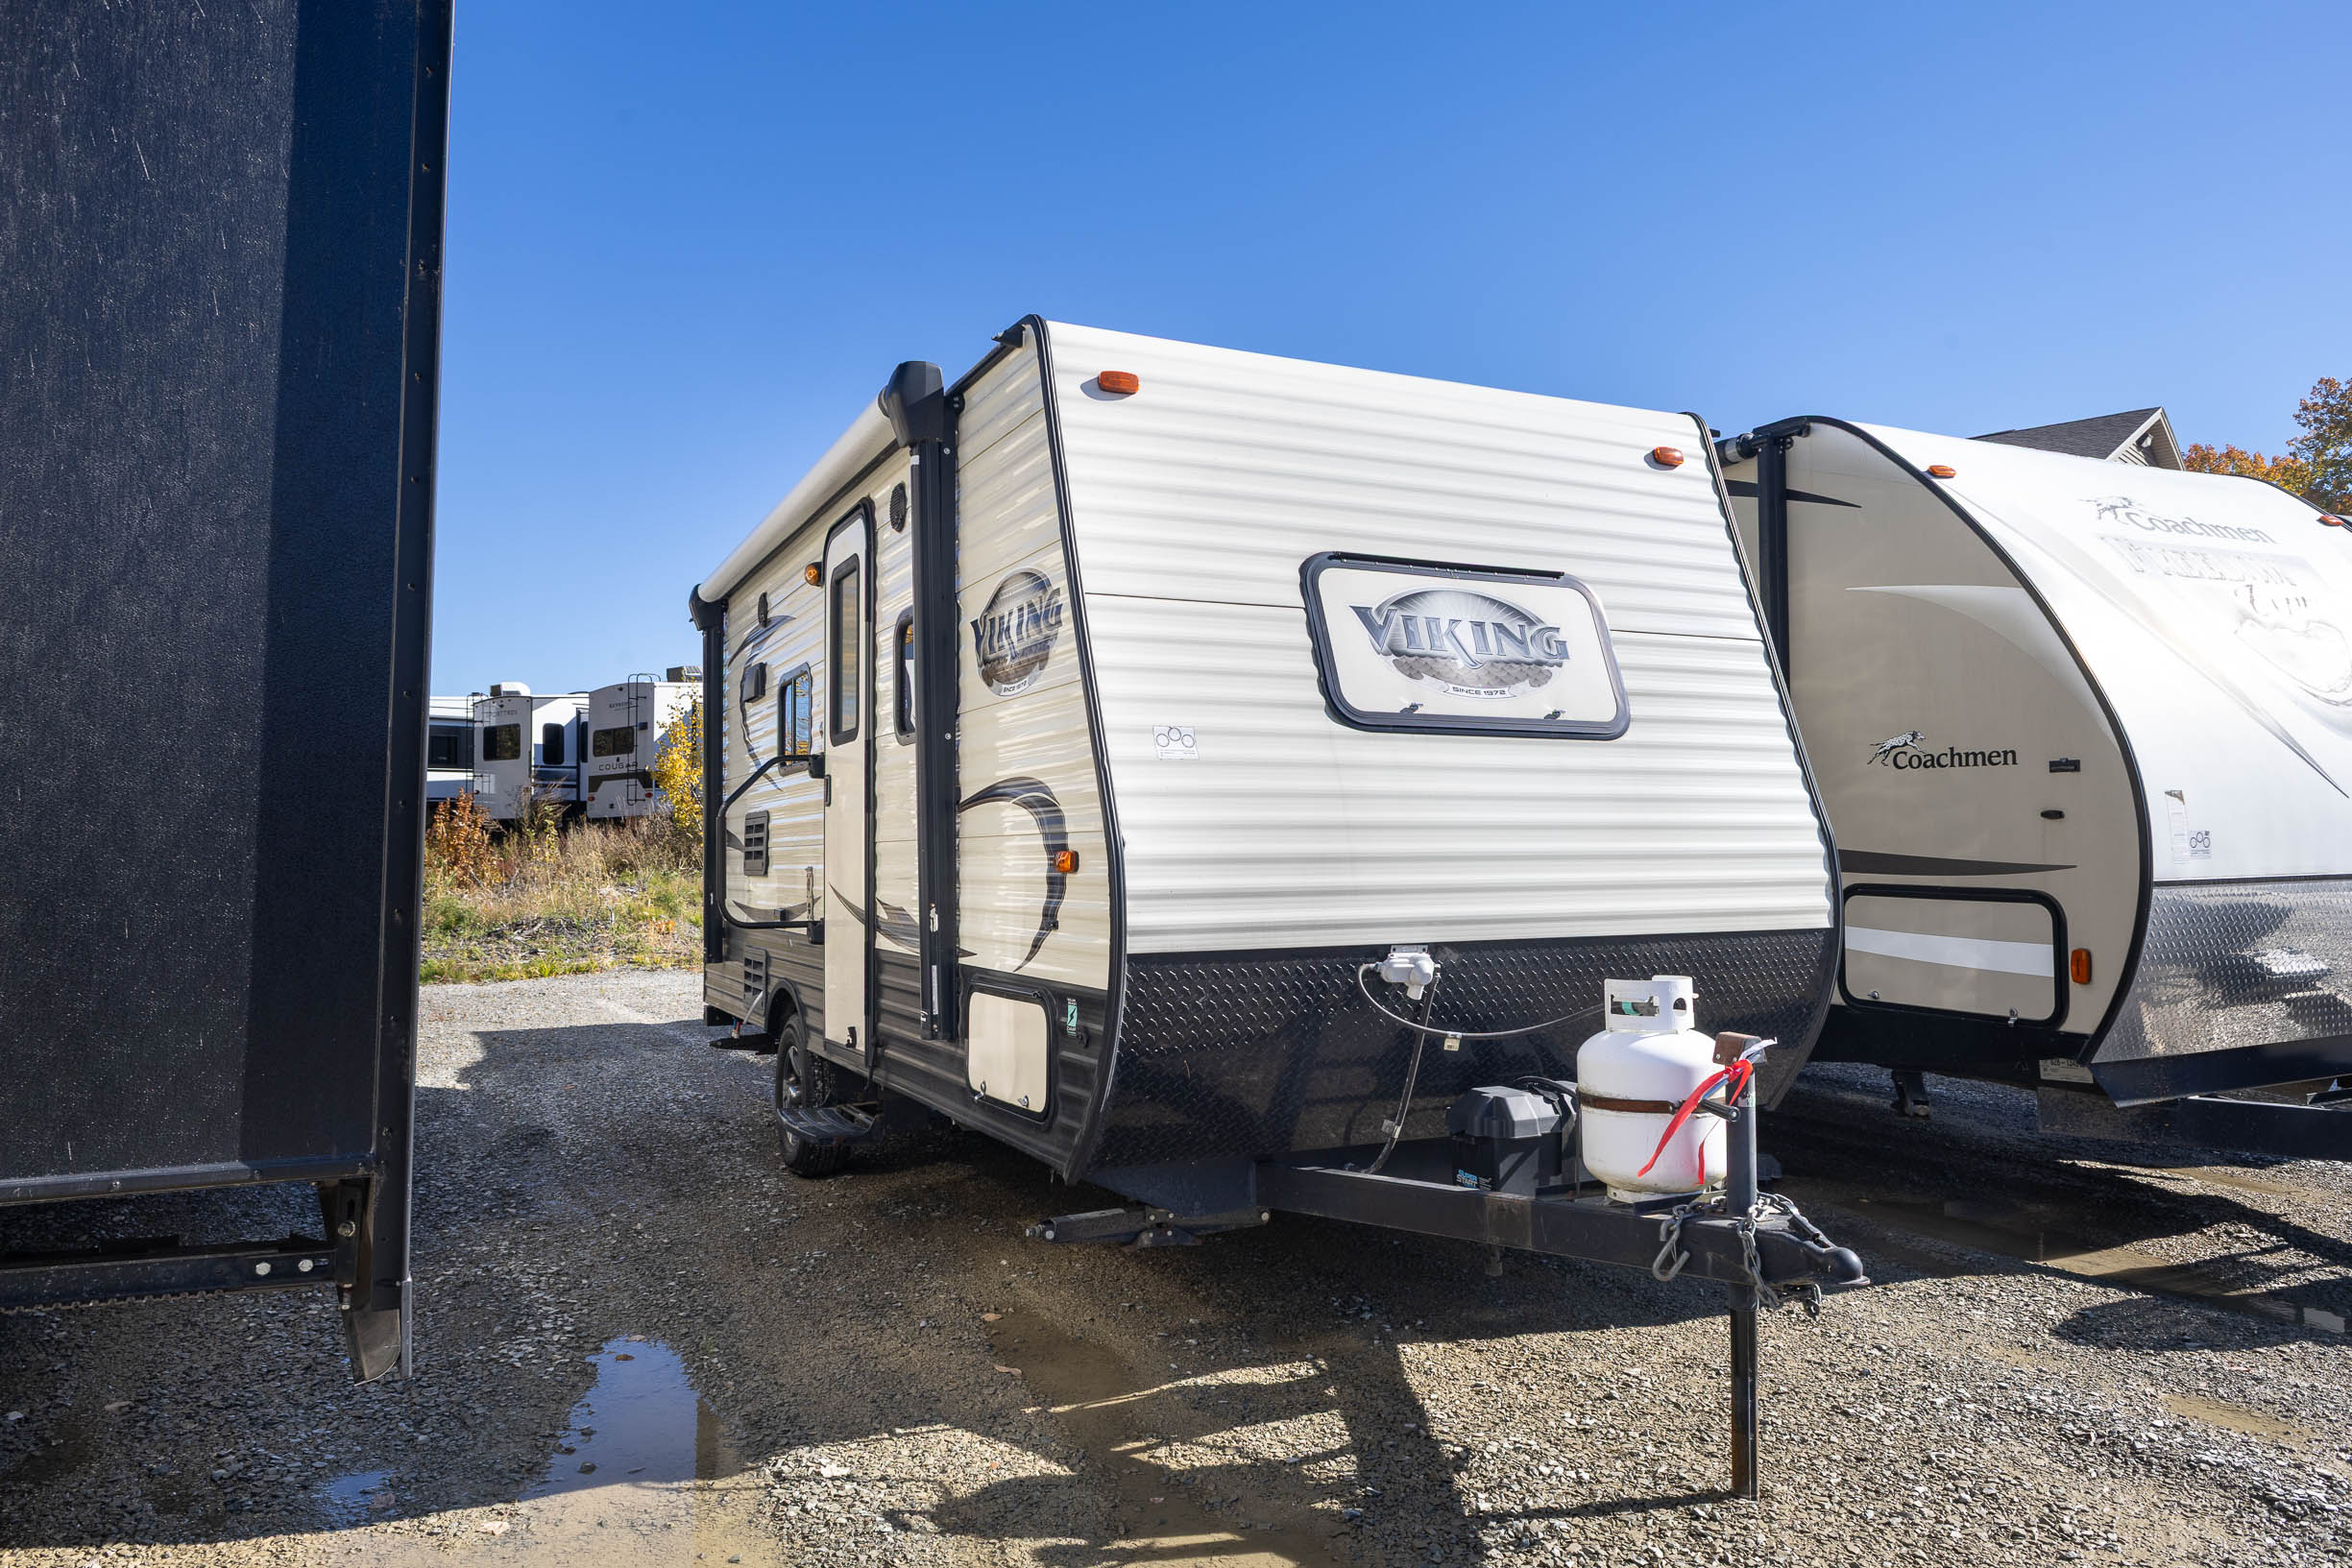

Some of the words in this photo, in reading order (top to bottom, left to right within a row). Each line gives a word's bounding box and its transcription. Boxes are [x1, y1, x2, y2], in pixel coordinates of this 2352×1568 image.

[2124, 512, 2279, 544] Coachmen
[970, 588, 1063, 663] VIKING
[1348, 605, 1570, 669] VIKING
[1452, 686, 1481, 695] SINCE
[598, 761, 638, 771] COUGAR
[1892, 746, 2019, 769] Coachmen
[1456, 1173, 1478, 1188] START
